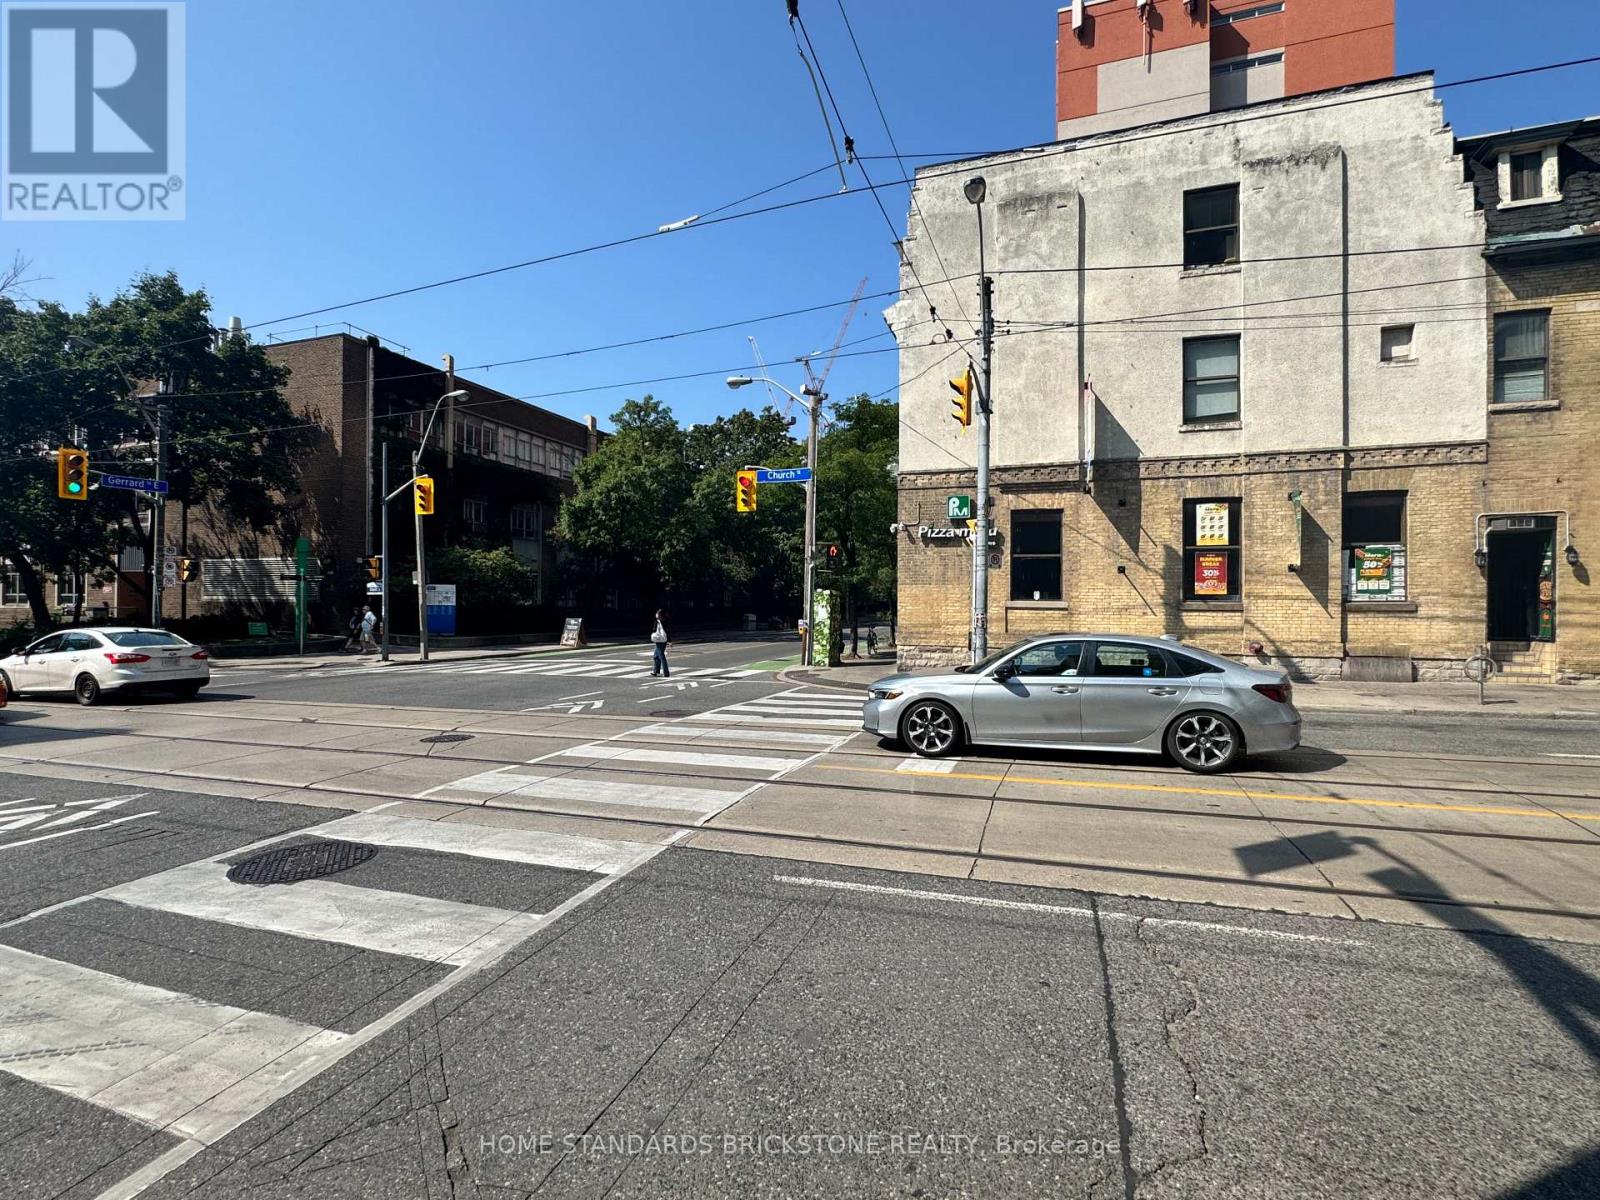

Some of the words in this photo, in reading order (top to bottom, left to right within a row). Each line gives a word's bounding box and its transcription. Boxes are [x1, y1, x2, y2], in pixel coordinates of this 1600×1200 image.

[768, 470, 795, 479] Church
[108, 476, 145, 488] Gerrard
[153, 481, 160, 490] E
[918, 525, 954, 538] Pizza
